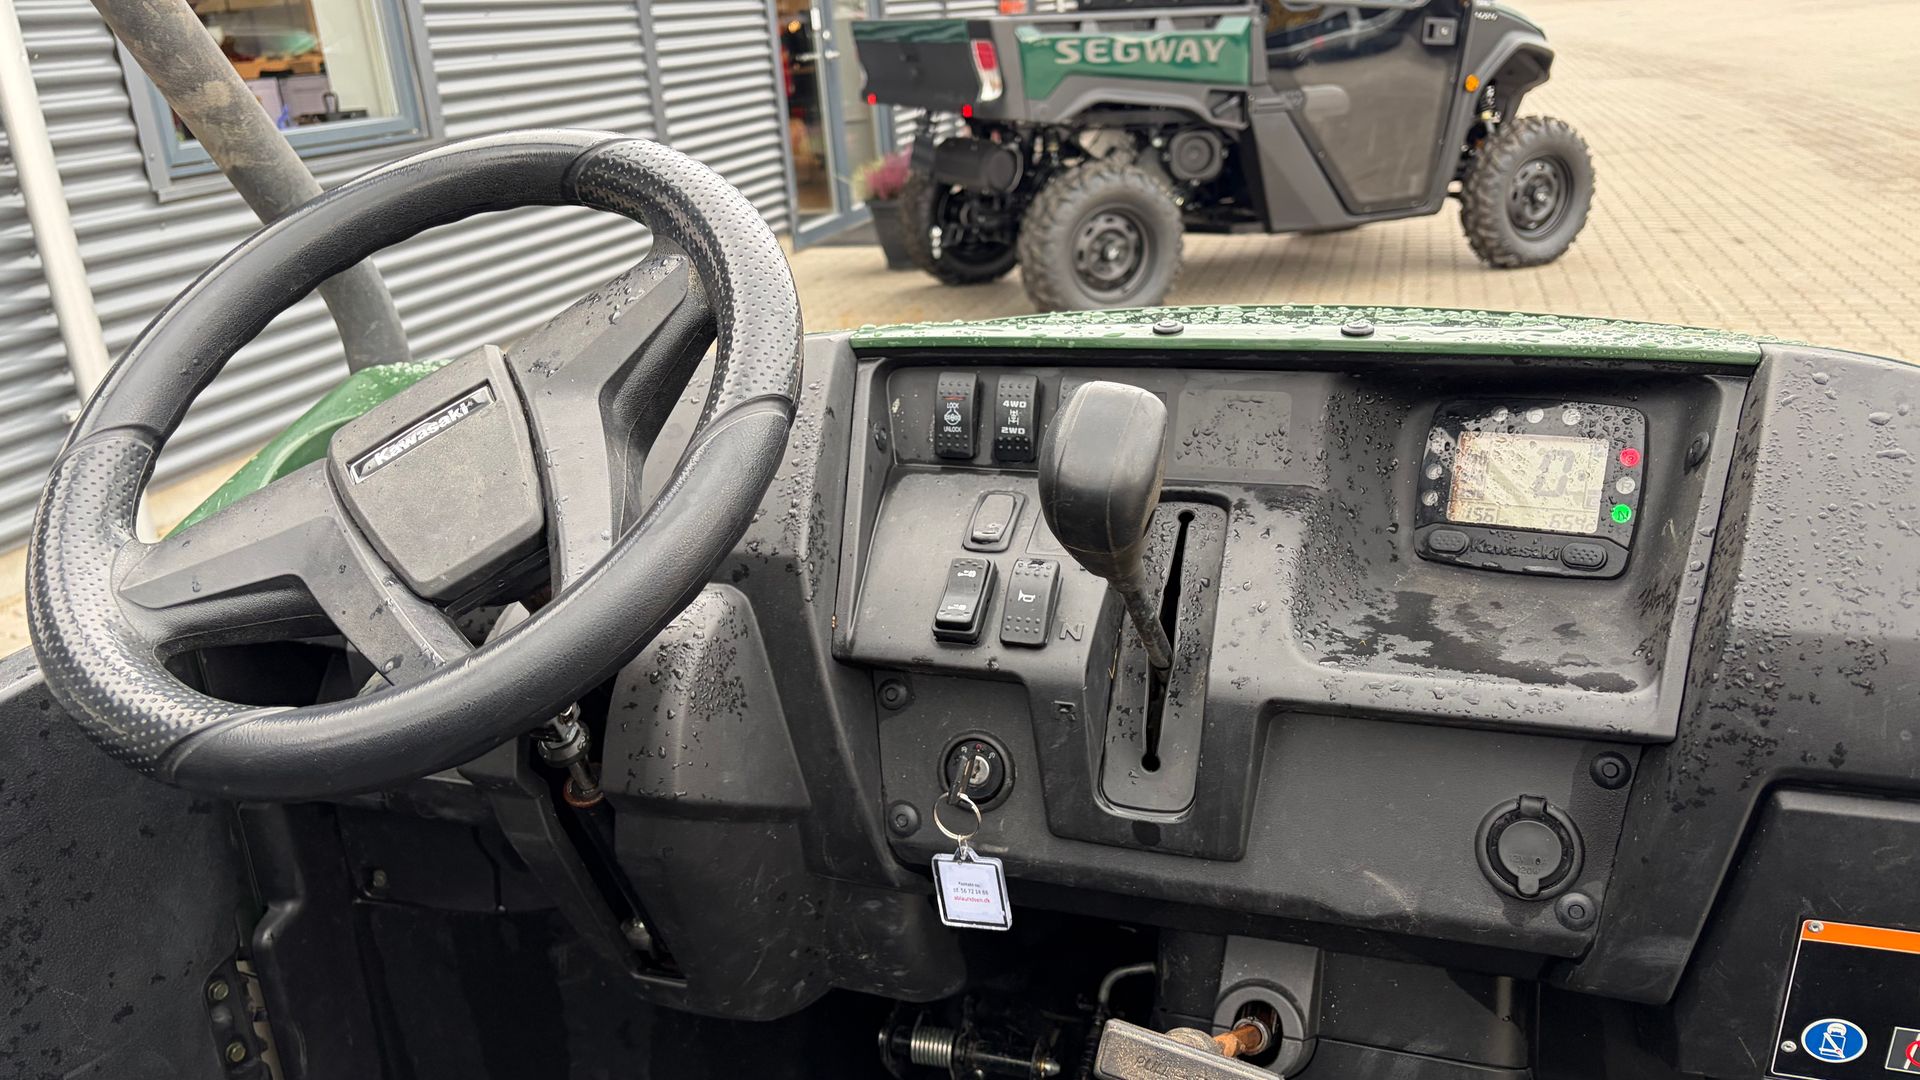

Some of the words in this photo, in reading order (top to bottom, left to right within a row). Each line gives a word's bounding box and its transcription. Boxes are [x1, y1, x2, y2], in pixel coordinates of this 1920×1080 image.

[1054, 37, 1228, 65] SEGWAY
[946, 401, 960, 409] LOCK
[1002, 400, 1027, 409] 4WD
[374, 400, 474, 466] Kawasaki
[1001, 426, 1026, 435] 2WD
[1470, 537, 1561, 561] Kawasaki
[1059, 622, 1085, 642] N
